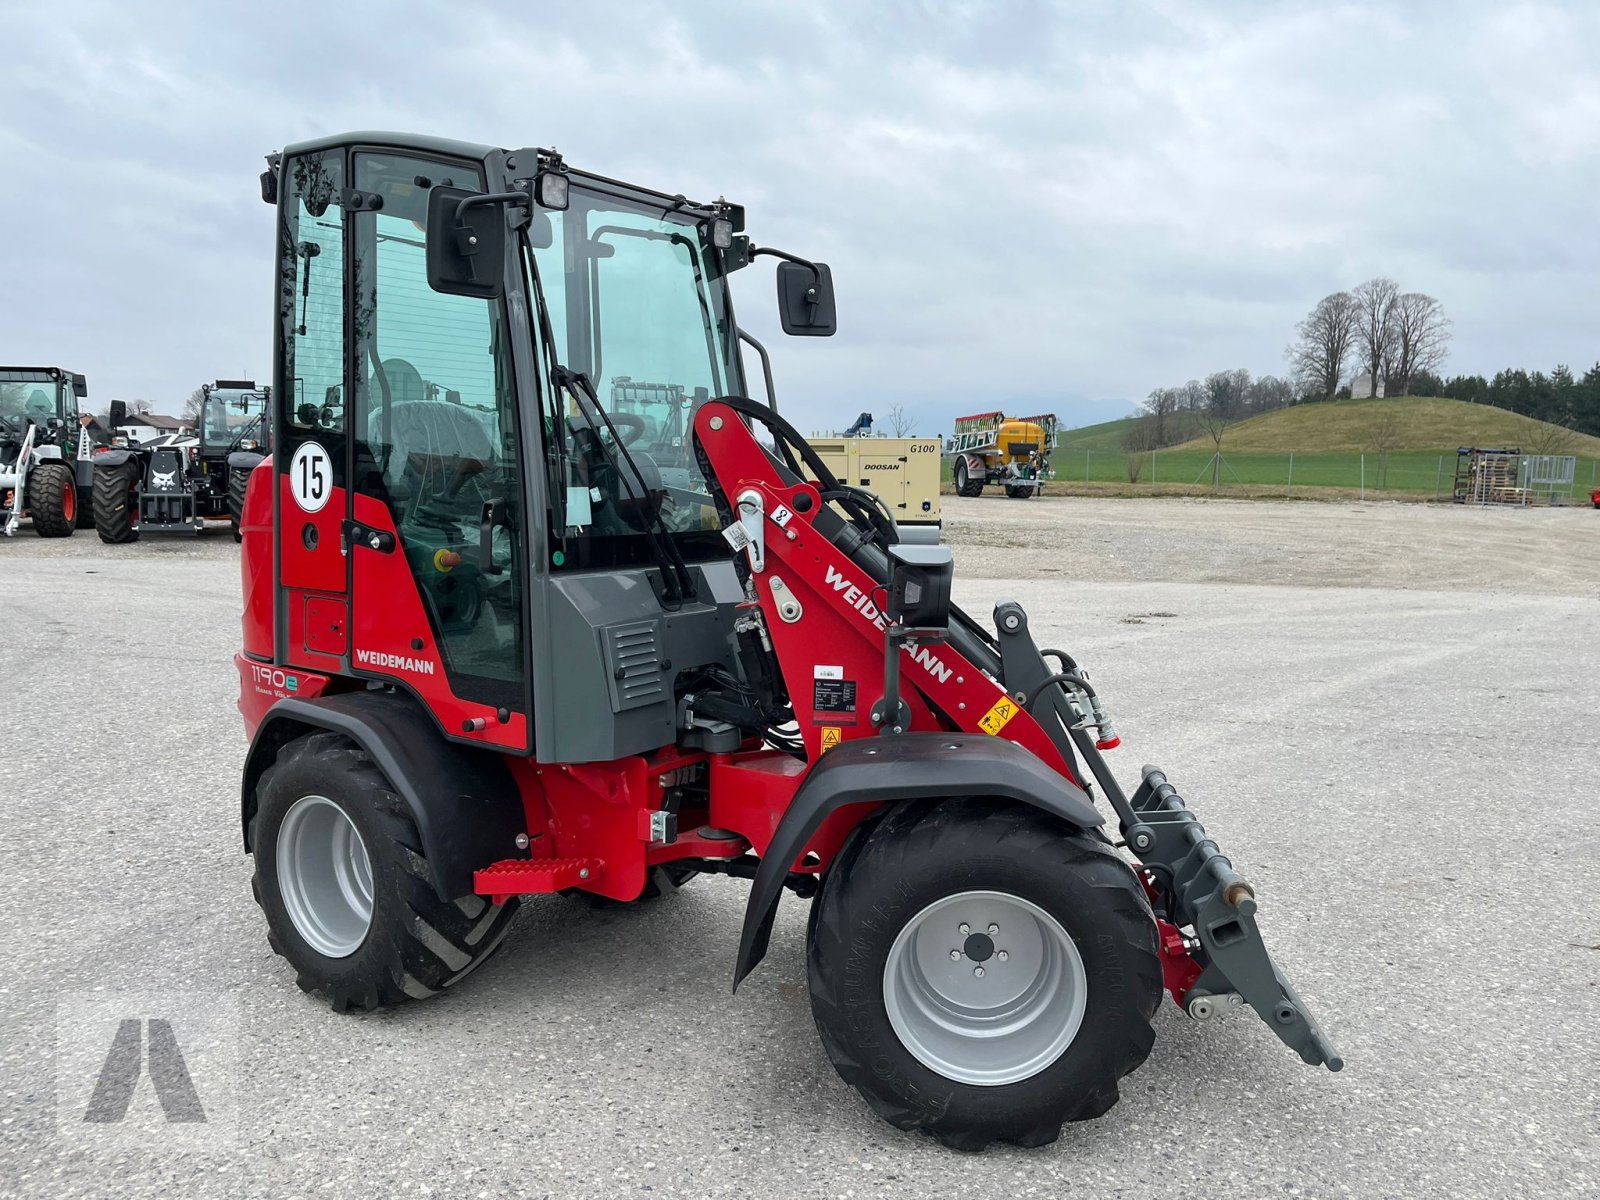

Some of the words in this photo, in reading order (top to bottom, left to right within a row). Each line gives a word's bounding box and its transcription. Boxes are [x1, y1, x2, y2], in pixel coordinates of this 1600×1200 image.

[911, 444, 934, 453] G100
[299, 455, 323, 499] 15
[824, 564, 953, 684] WEIDEANN
[356, 648, 434, 675] WEIDEMANN
